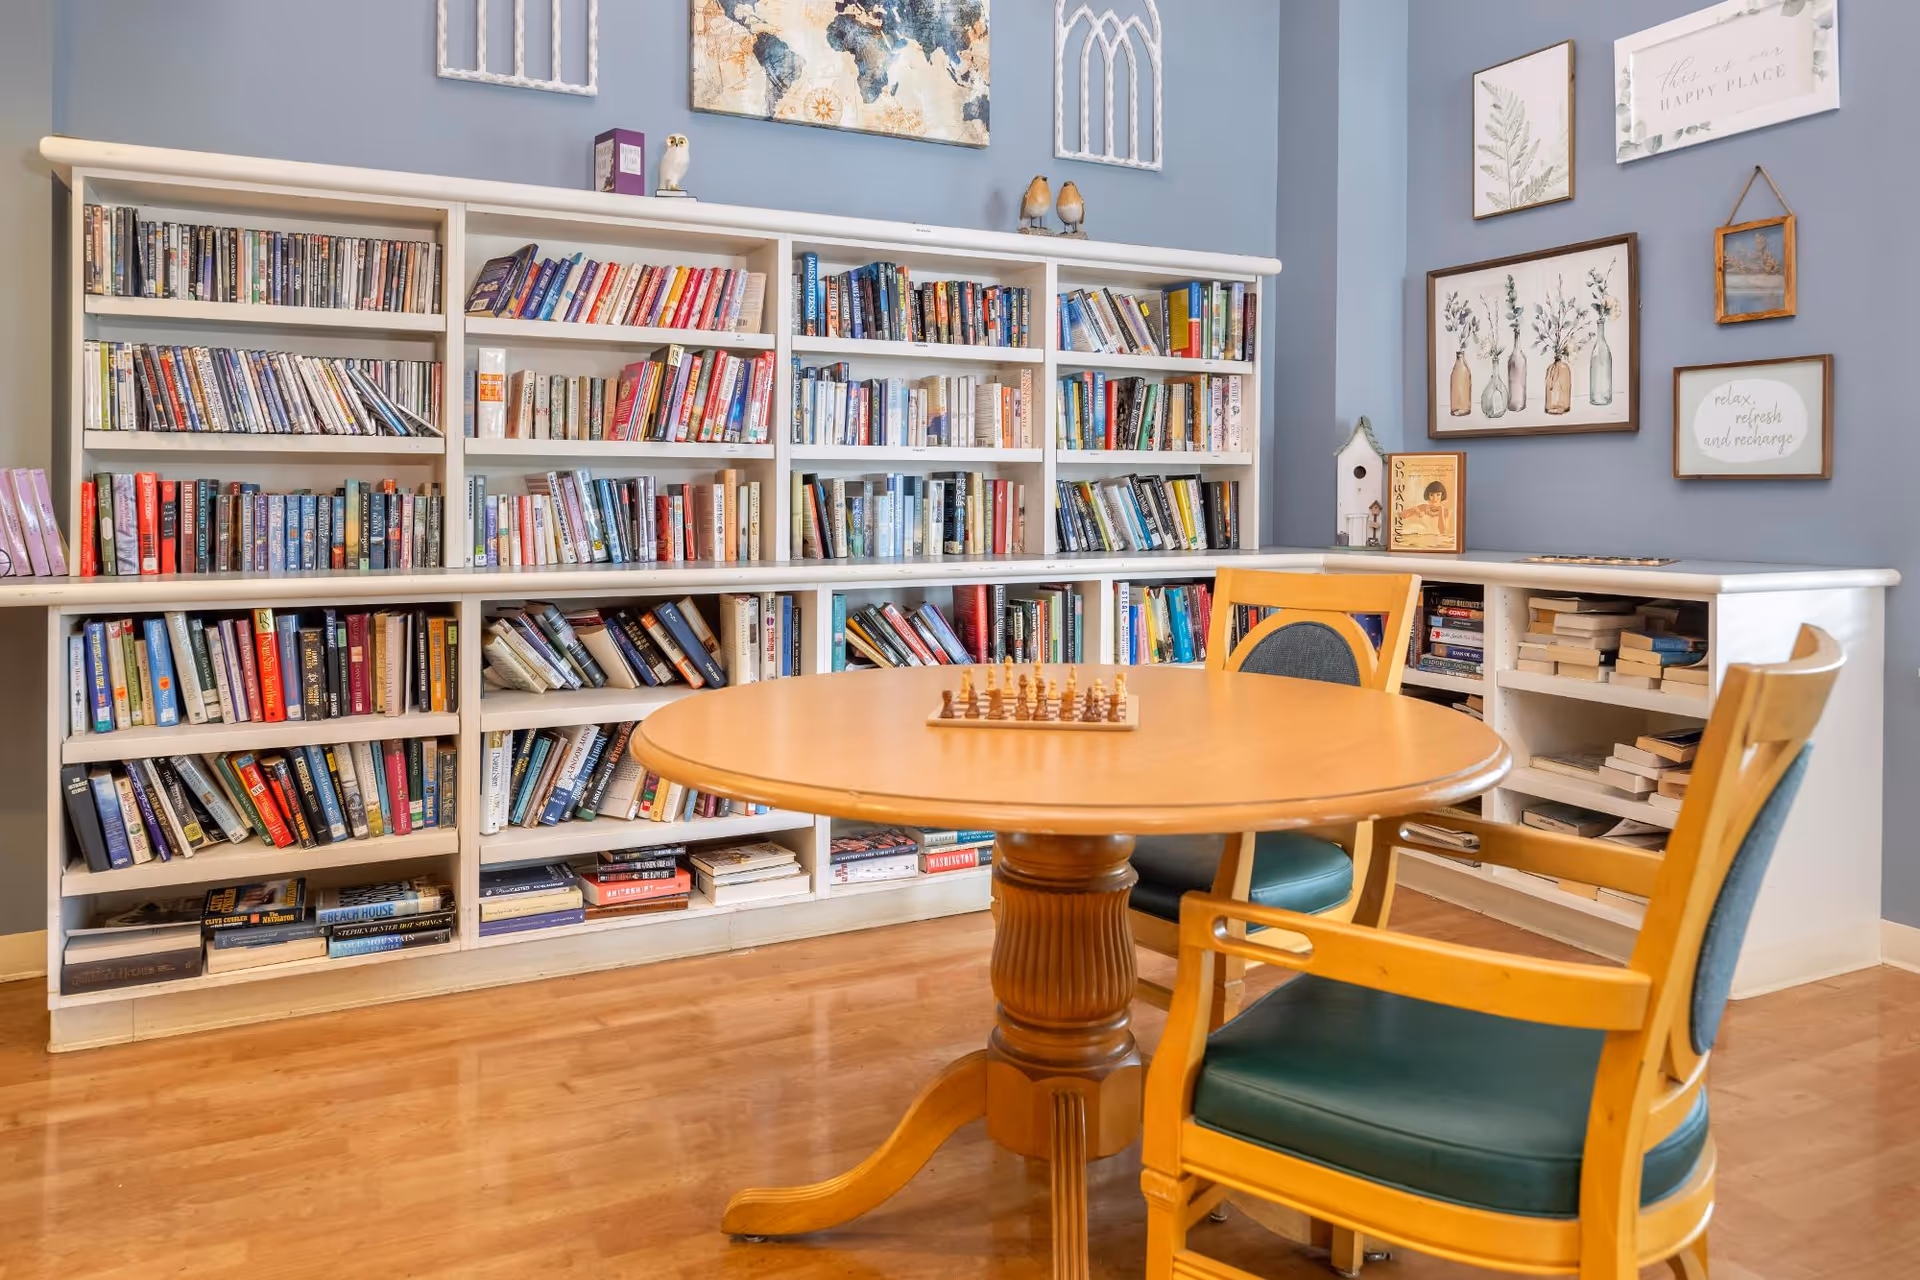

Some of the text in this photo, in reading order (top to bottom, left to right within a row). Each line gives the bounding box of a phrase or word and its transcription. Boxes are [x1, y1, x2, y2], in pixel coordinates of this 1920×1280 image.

[1660, 64, 1786, 111] HAPPY PLACE
[808, 256, 816, 319] JAMES PATTERSON
[1735, 401, 1784, 428] refresh
[1704, 424, 1794, 455] and recharge
[185, 484, 193, 492] THE
[567, 726, 591, 777] ANDY ROONEY
[584, 734, 608, 775] NIGHTFALL
[609, 734, 627, 763] CUSSLER
[930, 852, 973, 869] WASHINGTON
[223, 915, 248, 923] CUSSLER
[262, 914, 294, 924] NAVIGATOR
[327, 911, 359, 923] BEACH
[361, 904, 394, 918] HOUSE
[337, 919, 442, 936] STEPHEN HUNTER HOT SPRINGS
[367, 934, 415, 946] MOUNTAIN
